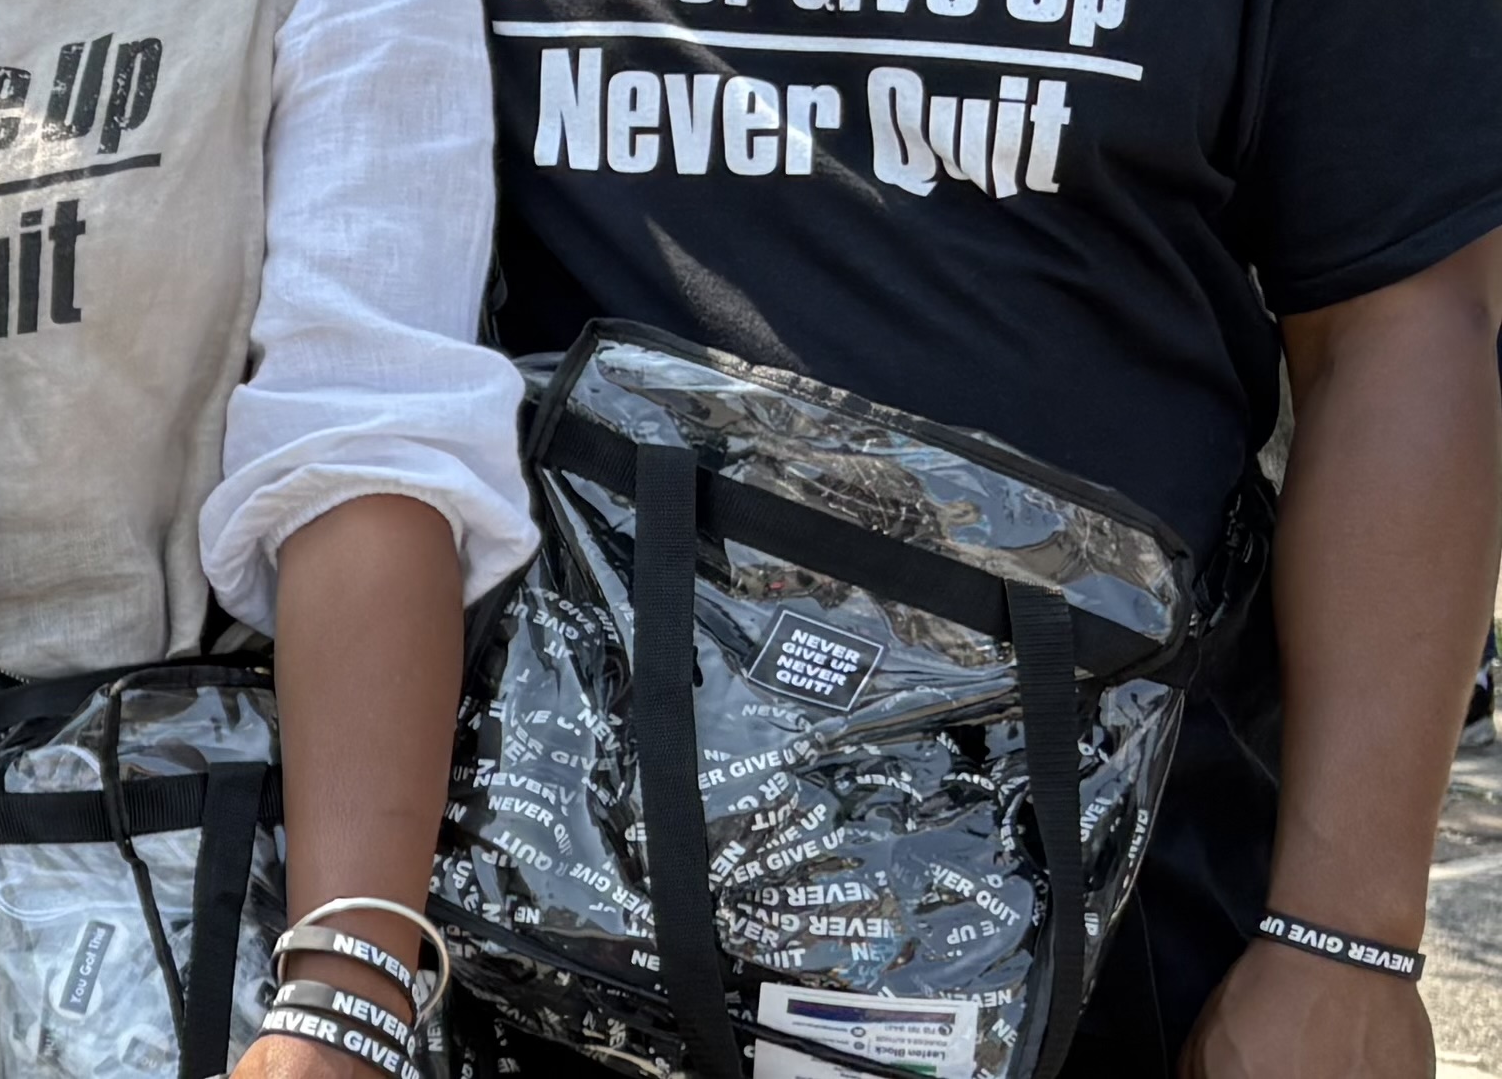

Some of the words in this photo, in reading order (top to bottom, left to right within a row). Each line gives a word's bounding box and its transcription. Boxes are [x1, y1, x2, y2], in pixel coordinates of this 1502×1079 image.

[41, 33, 163, 154] Up
[534, 48, 841, 177] Never
[867, 66, 1072, 199] Quit
[533, 609, 579, 641] GIVE
[782, 642, 827, 665] GIVE
[830, 658, 857, 673] UP
[791, 629, 860, 664] NEVER
[776, 655, 847, 687] NEVER
[776, 669, 834, 696] QUIT!
[577, 707, 621, 752] NEV
[729, 750, 782, 778] GIVE
[473, 772, 557, 805] NEVER
[487, 795, 554, 827] NEVER
[800, 803, 827, 831] UP
[493, 830, 553, 872] QUIT
[766, 840, 820, 871] GIVE
[822, 826, 846, 851] UP
[569, 862, 612, 893] GIVE
[611, 885, 656, 927] VER
[975, 889, 1021, 927] QUIT
[729, 916, 780, 949] VER
[947, 924, 977, 945] UP
[1259, 915, 1285, 937] UP
[1288, 924, 1344, 954] GIVE
[333, 934, 411, 988] NEVER
[1347, 941, 1415, 974] NEVER
[69, 978, 88, 1004] You
[79, 952, 98, 976] Got
[332, 991, 408, 1046] NEVER
[262, 1011, 338, 1043] NEVER
[343, 1030, 398, 1073] GIVE
